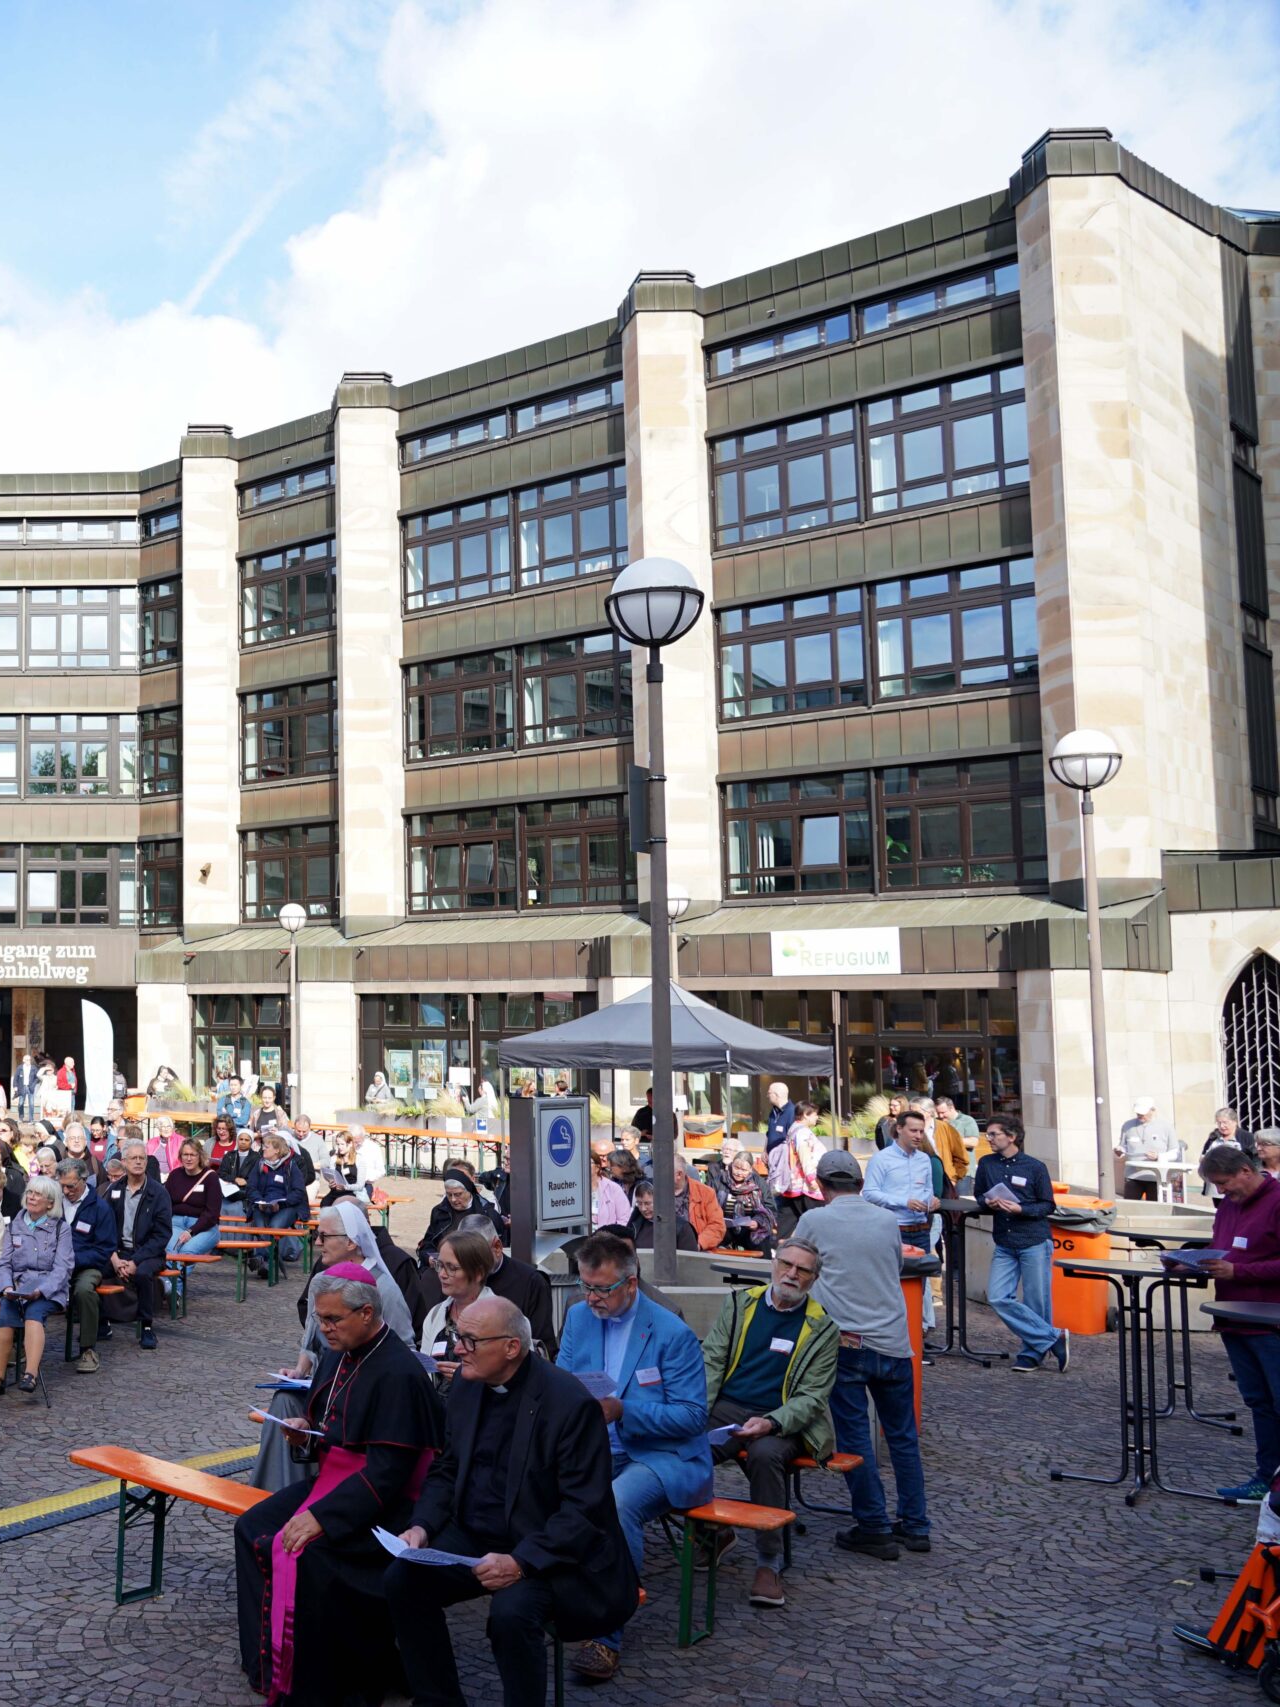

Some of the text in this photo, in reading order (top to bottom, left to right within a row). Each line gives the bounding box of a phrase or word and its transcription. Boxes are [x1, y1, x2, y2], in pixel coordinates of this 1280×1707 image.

[55, 944, 97, 959] zum
[548, 1180, 577, 1192] Raucher-
[550, 1197, 576, 1208] bereich
[1052, 1239, 1075, 1251] DG
